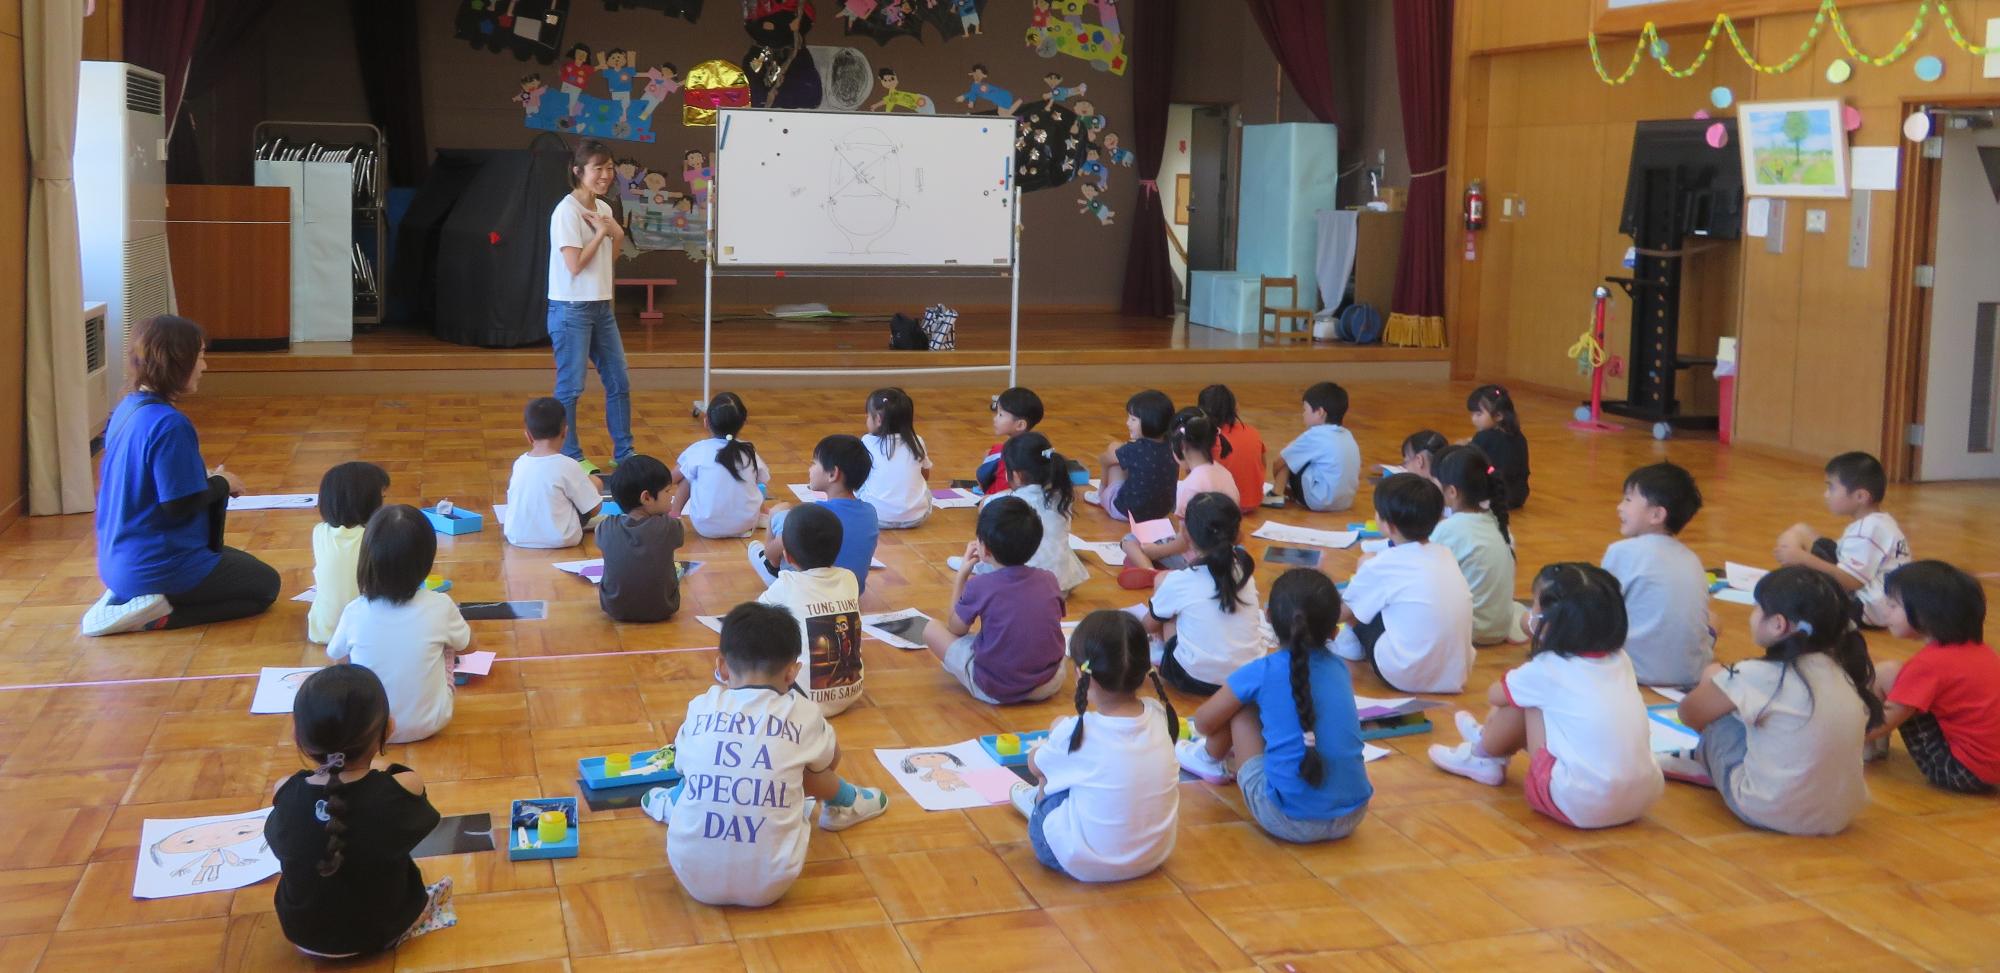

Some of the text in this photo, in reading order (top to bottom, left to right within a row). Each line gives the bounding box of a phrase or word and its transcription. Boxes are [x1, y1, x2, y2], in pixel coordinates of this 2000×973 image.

[805, 601, 835, 616] TUNG
[809, 690, 836, 703] TUNG
[692, 711, 802, 744] EVERY DAY
[713, 741, 772, 769] IS A
[687, 774, 791, 808] SPECIAL
[704, 811, 767, 843] DAY
